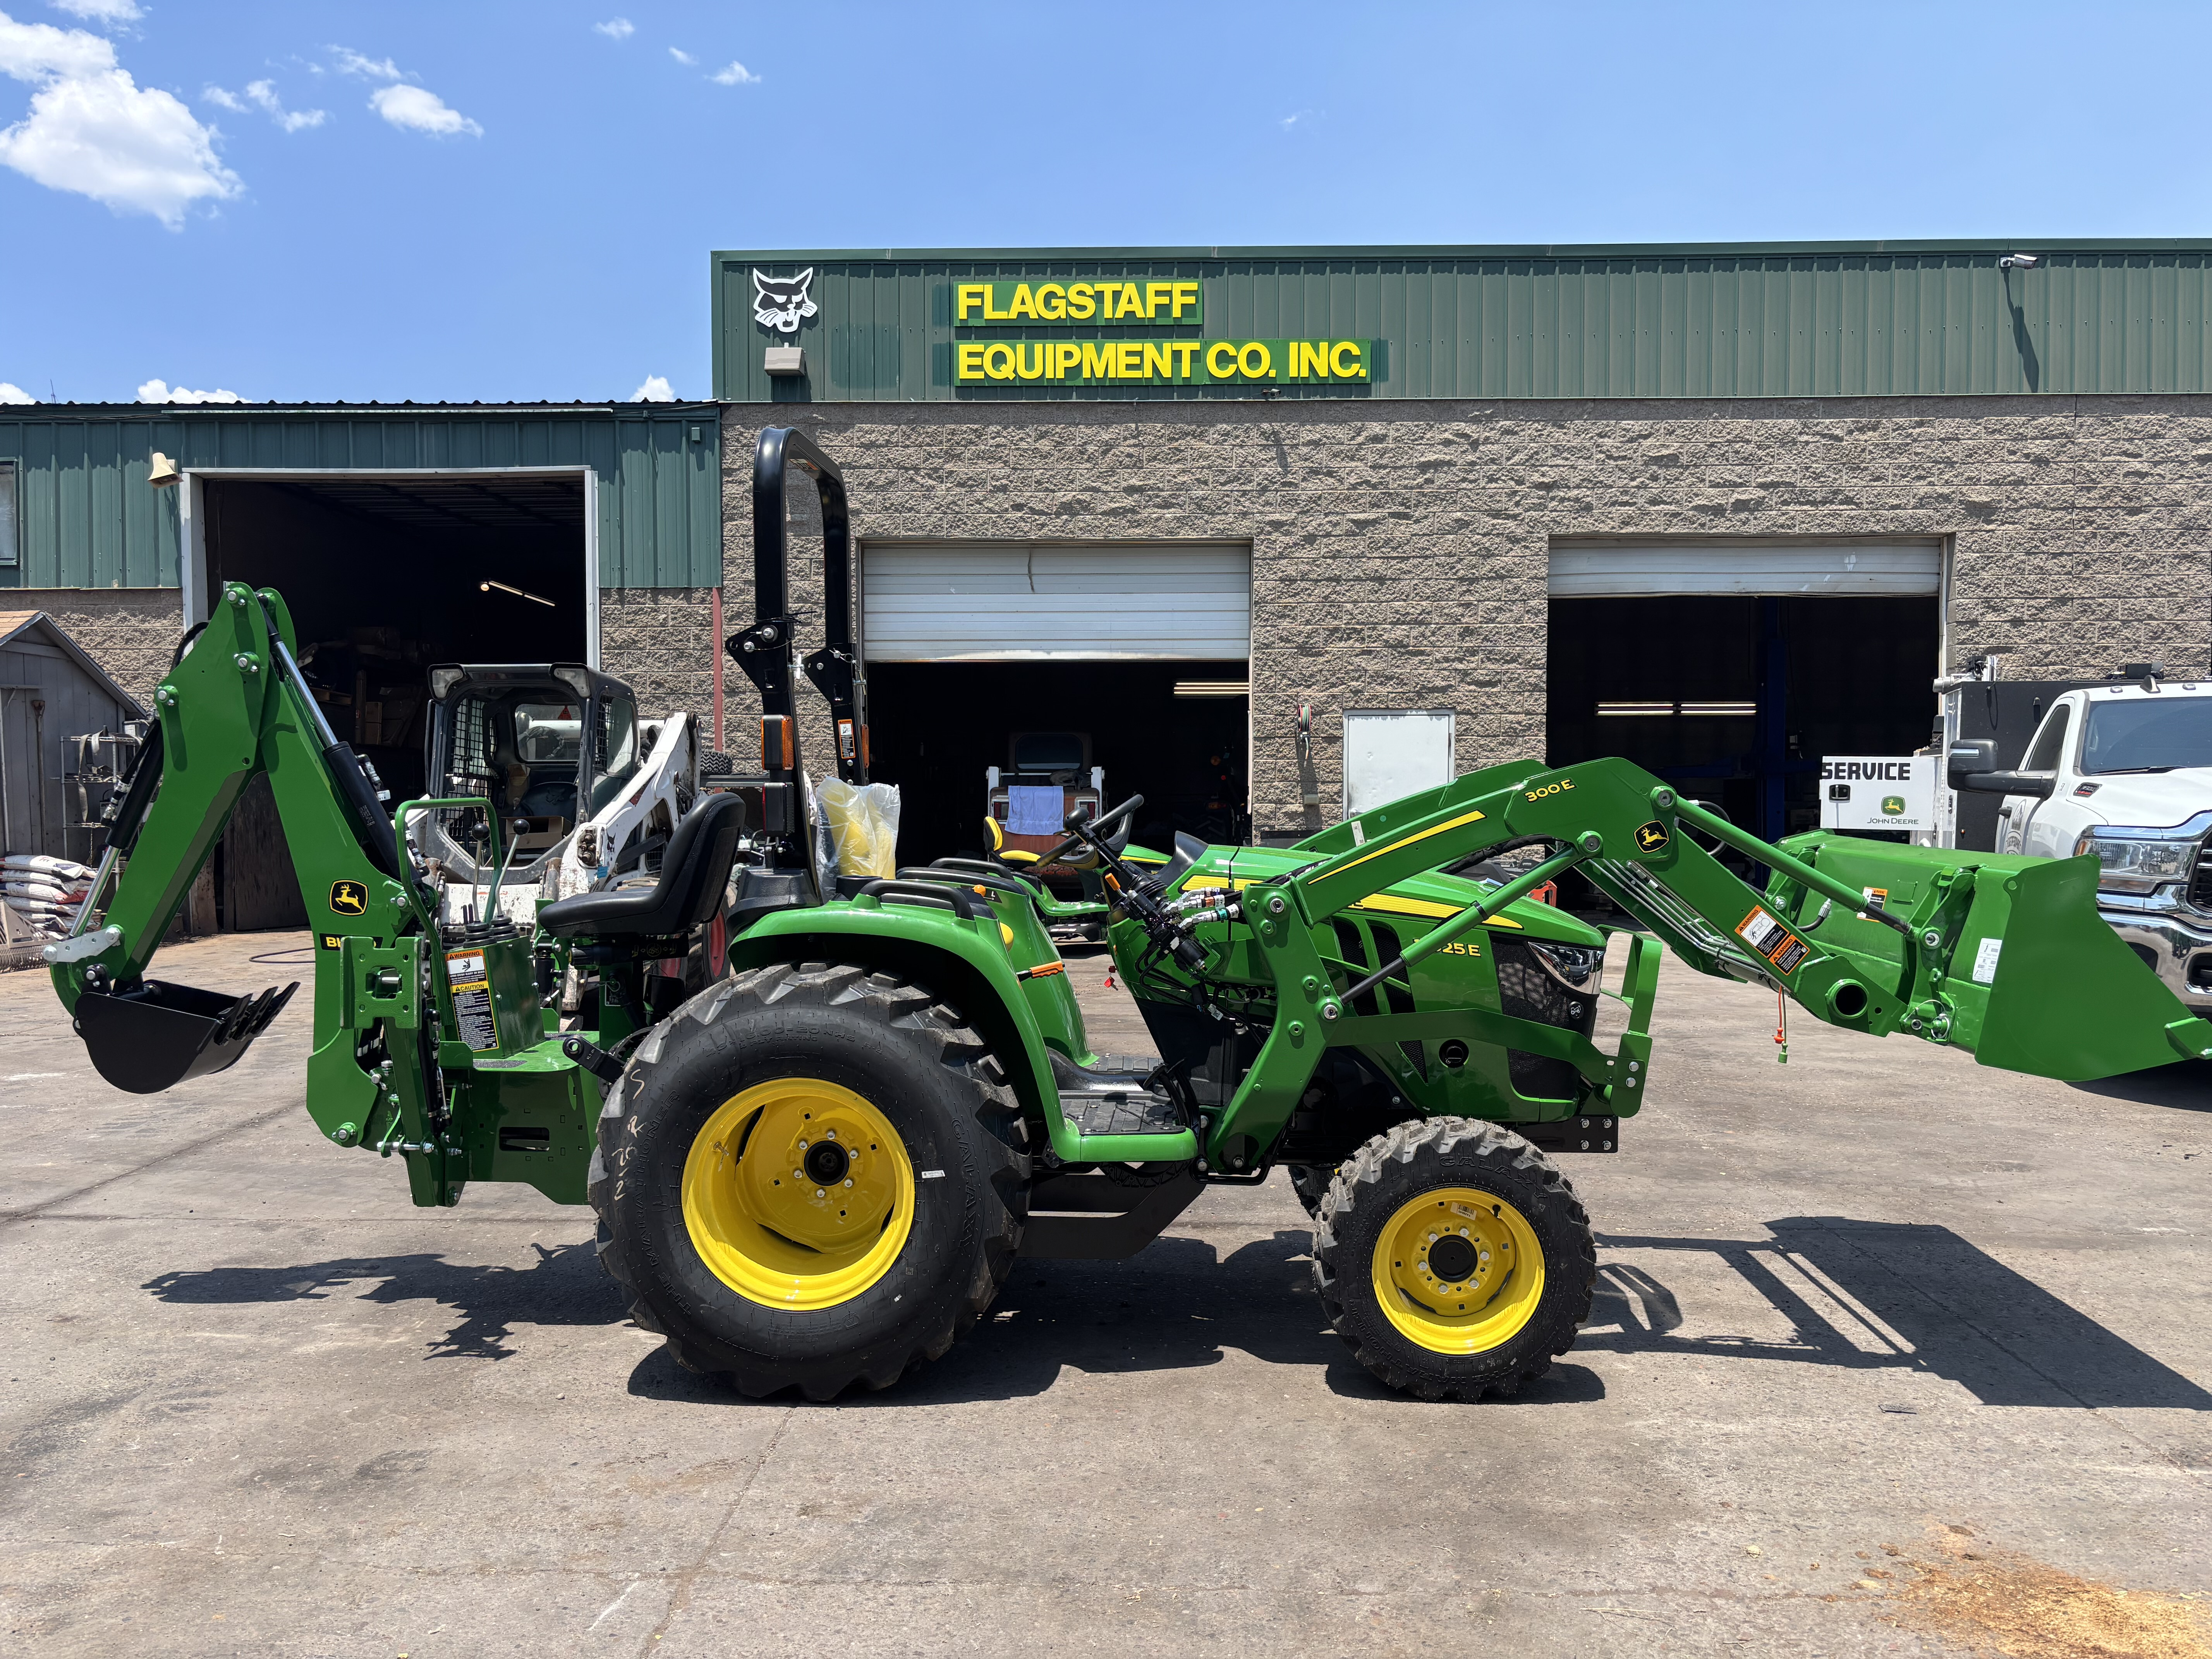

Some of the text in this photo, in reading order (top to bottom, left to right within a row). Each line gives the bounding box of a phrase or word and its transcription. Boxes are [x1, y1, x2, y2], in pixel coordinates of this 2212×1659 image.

[958, 282, 1198, 320] FLAGSTAFF
[959, 342, 1367, 379] EQUIPMENT CO. INC.
[1821, 762, 1910, 780] SERVICE
[1742, 909, 1759, 927] WARNING
[1777, 938, 1793, 956] WARNING
